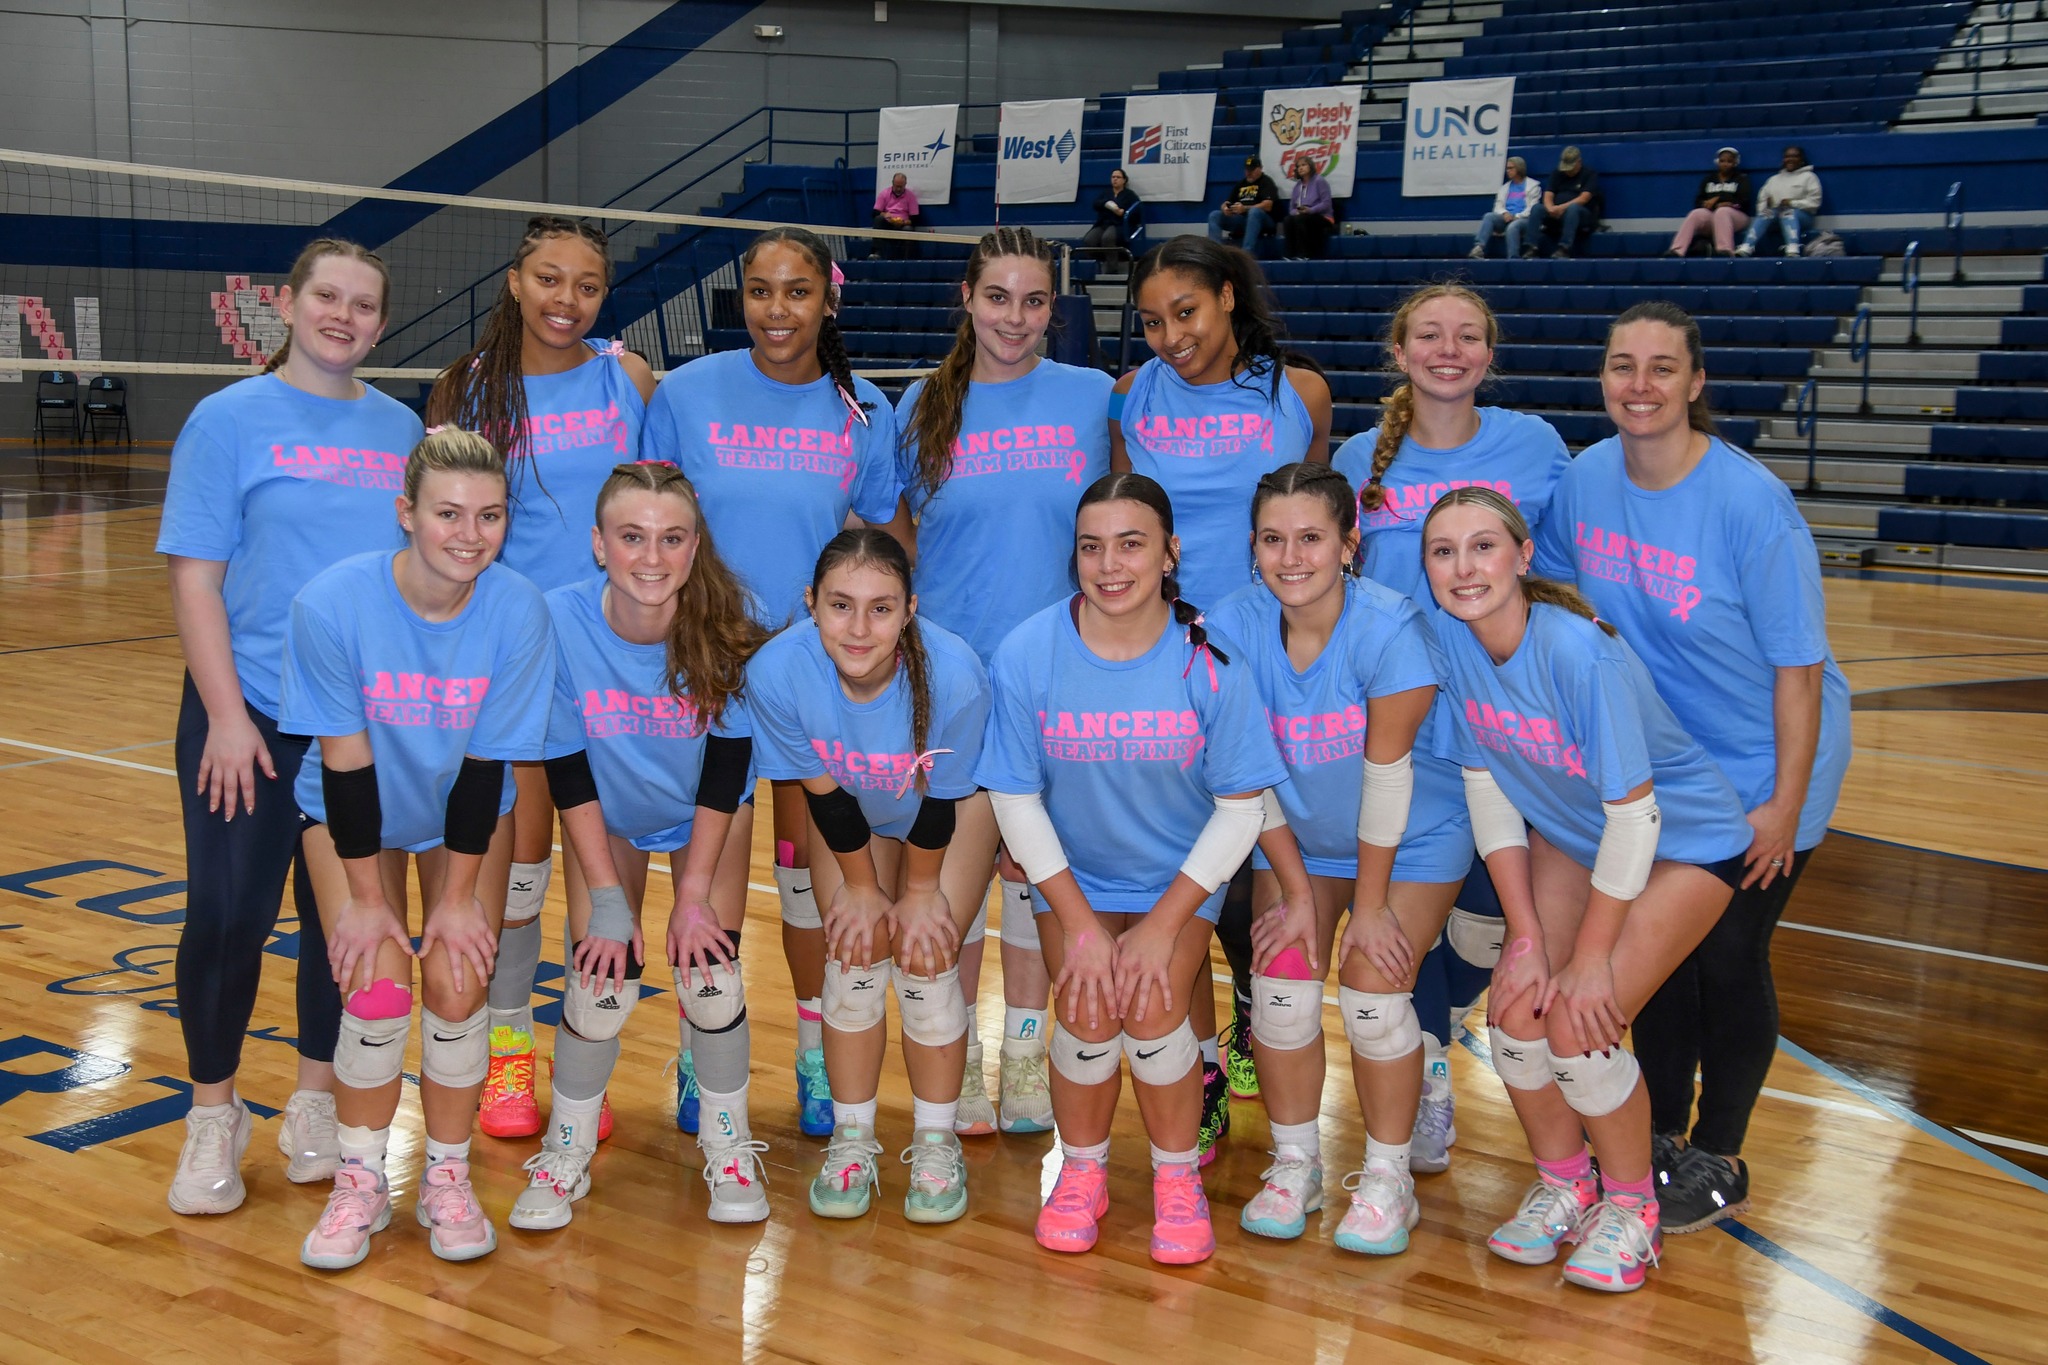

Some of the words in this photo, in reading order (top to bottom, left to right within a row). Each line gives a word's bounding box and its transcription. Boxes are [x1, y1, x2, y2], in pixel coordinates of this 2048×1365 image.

[1306, 102, 1353, 123] piggly
[1414, 103, 1500, 139] UNC
[1166, 126, 1189, 137] First
[1303, 121, 1352, 140] wiggly
[883, 152, 929, 163] SPIRIT
[1003, 135, 1055, 160] West
[1164, 139, 1207, 151] Citizens
[1280, 141, 1342, 166] Fresh
[1413, 143, 1496, 160] HEALTH
[1163, 153, 1190, 165] Bank
[1135, 413, 1263, 438] LANCER
[708, 422, 853, 457] LANCERS
[949, 425, 1076, 457] ANCERS
[271, 444, 409, 473] LANCER
[715, 447, 785, 470] TEAM
[789, 452, 845, 477] PINK
[947, 454, 1002, 479] EAM
[1007, 449, 1071, 471] PINK
[357, 471, 405, 491] PIN
[1576, 521, 1697, 581] LANCERS
[363, 671, 490, 706] ANCER
[582, 689, 699, 719] ANCER
[434, 704, 481, 730] PIN
[583, 714, 638, 739] EAM
[643, 718, 698, 739] PIN
[1037, 710, 1198, 738] LANCERS
[1042, 738, 1117, 762] TEAM
[1122, 738, 1190, 761] PINK
[1302, 733, 1365, 765] PINK
[859, 774, 914, 791] PIN
[595, 1001, 620, 1010] adidas
[697, 990, 723, 998] adidas
